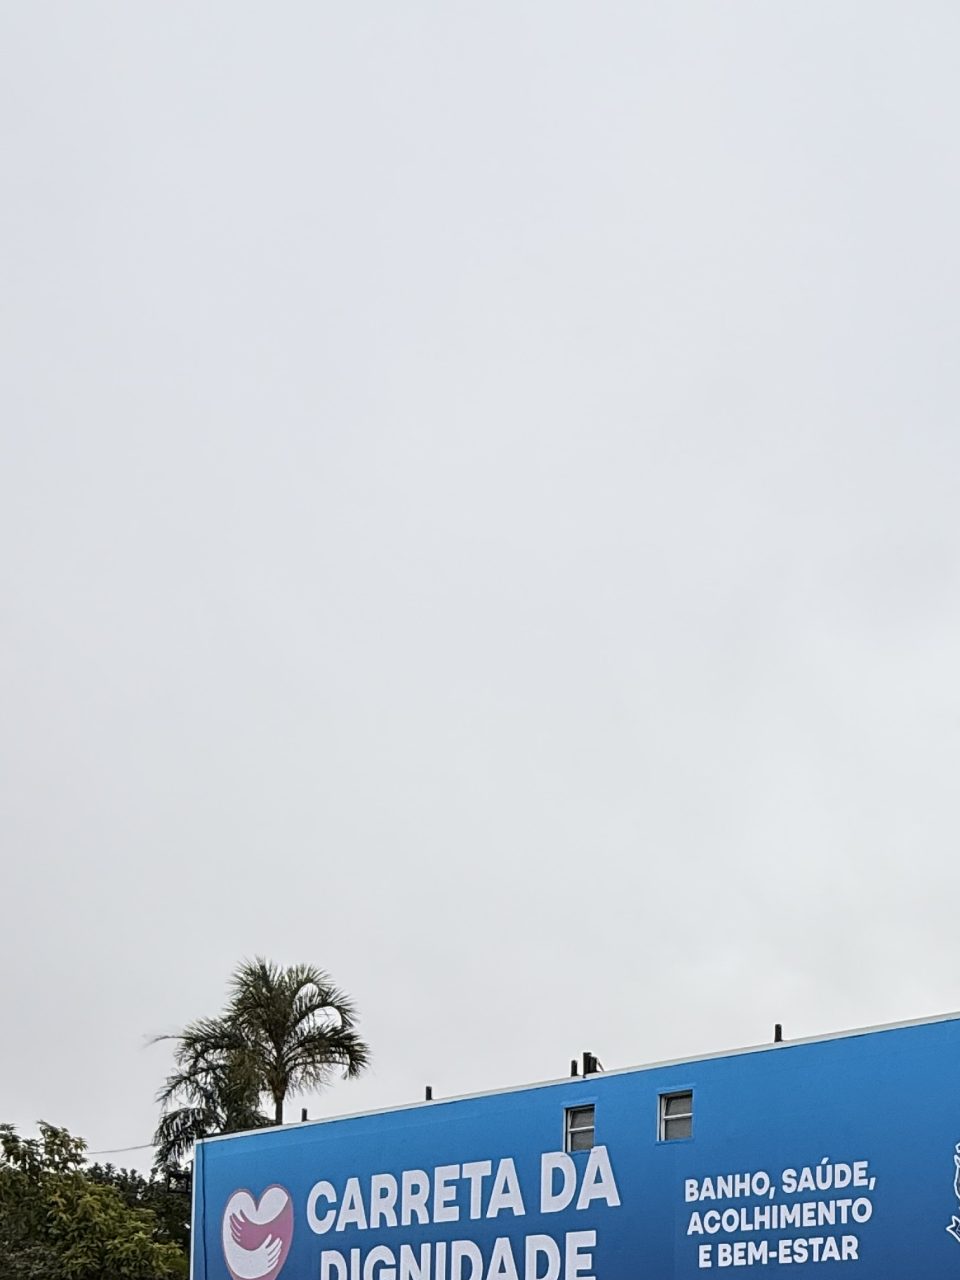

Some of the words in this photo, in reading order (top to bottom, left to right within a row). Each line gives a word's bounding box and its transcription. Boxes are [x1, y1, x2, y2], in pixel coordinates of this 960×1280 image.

[306, 1157, 526, 1235] CARRETA
[541, 1145, 621, 1214] DA
[685, 1171, 776, 1203] BANHO,
[781, 1157, 876, 1195] SAÚDE,
[686, 1197, 873, 1236] ACOLHIMENTO
[698, 1244, 712, 1269] E
[717, 1234, 859, 1268] BEM-ESTAR
